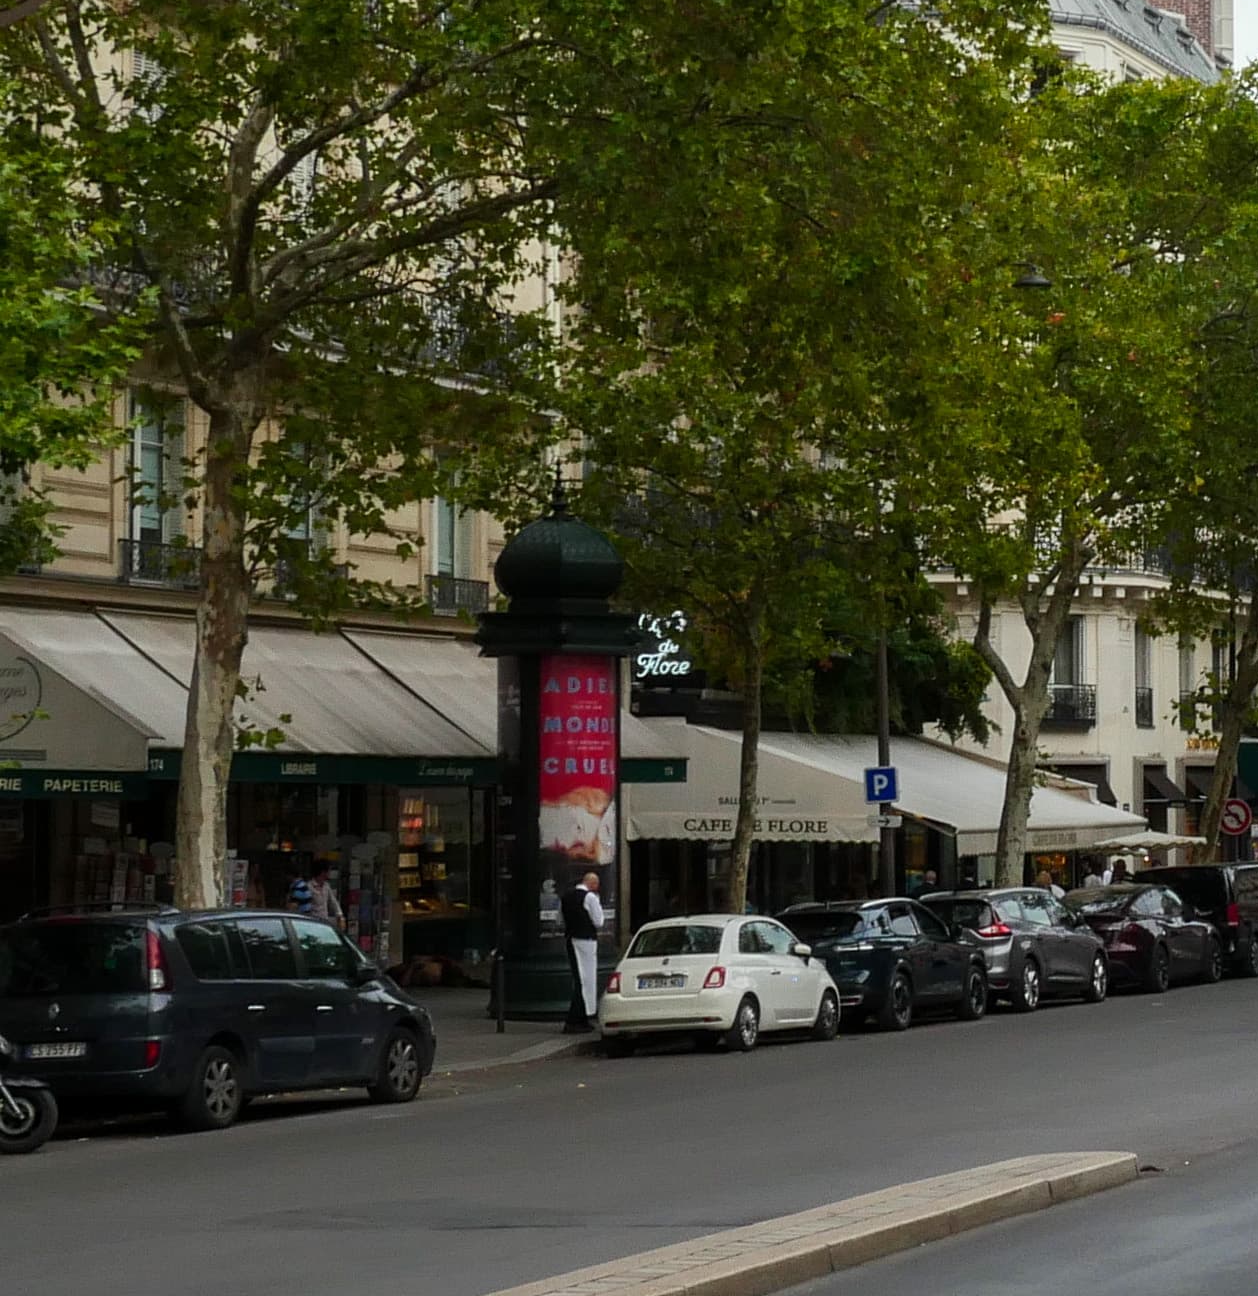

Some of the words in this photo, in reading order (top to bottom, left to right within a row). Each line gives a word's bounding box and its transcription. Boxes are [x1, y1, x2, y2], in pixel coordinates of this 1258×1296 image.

[636, 652, 691, 678] Flore
[544, 677, 614, 694] ADIE
[44, 779, 124, 793] PAPETERIE
[873, 774, 889, 796] P
[684, 819, 733, 832] CAFE
[768, 820, 828, 833] FLORE
